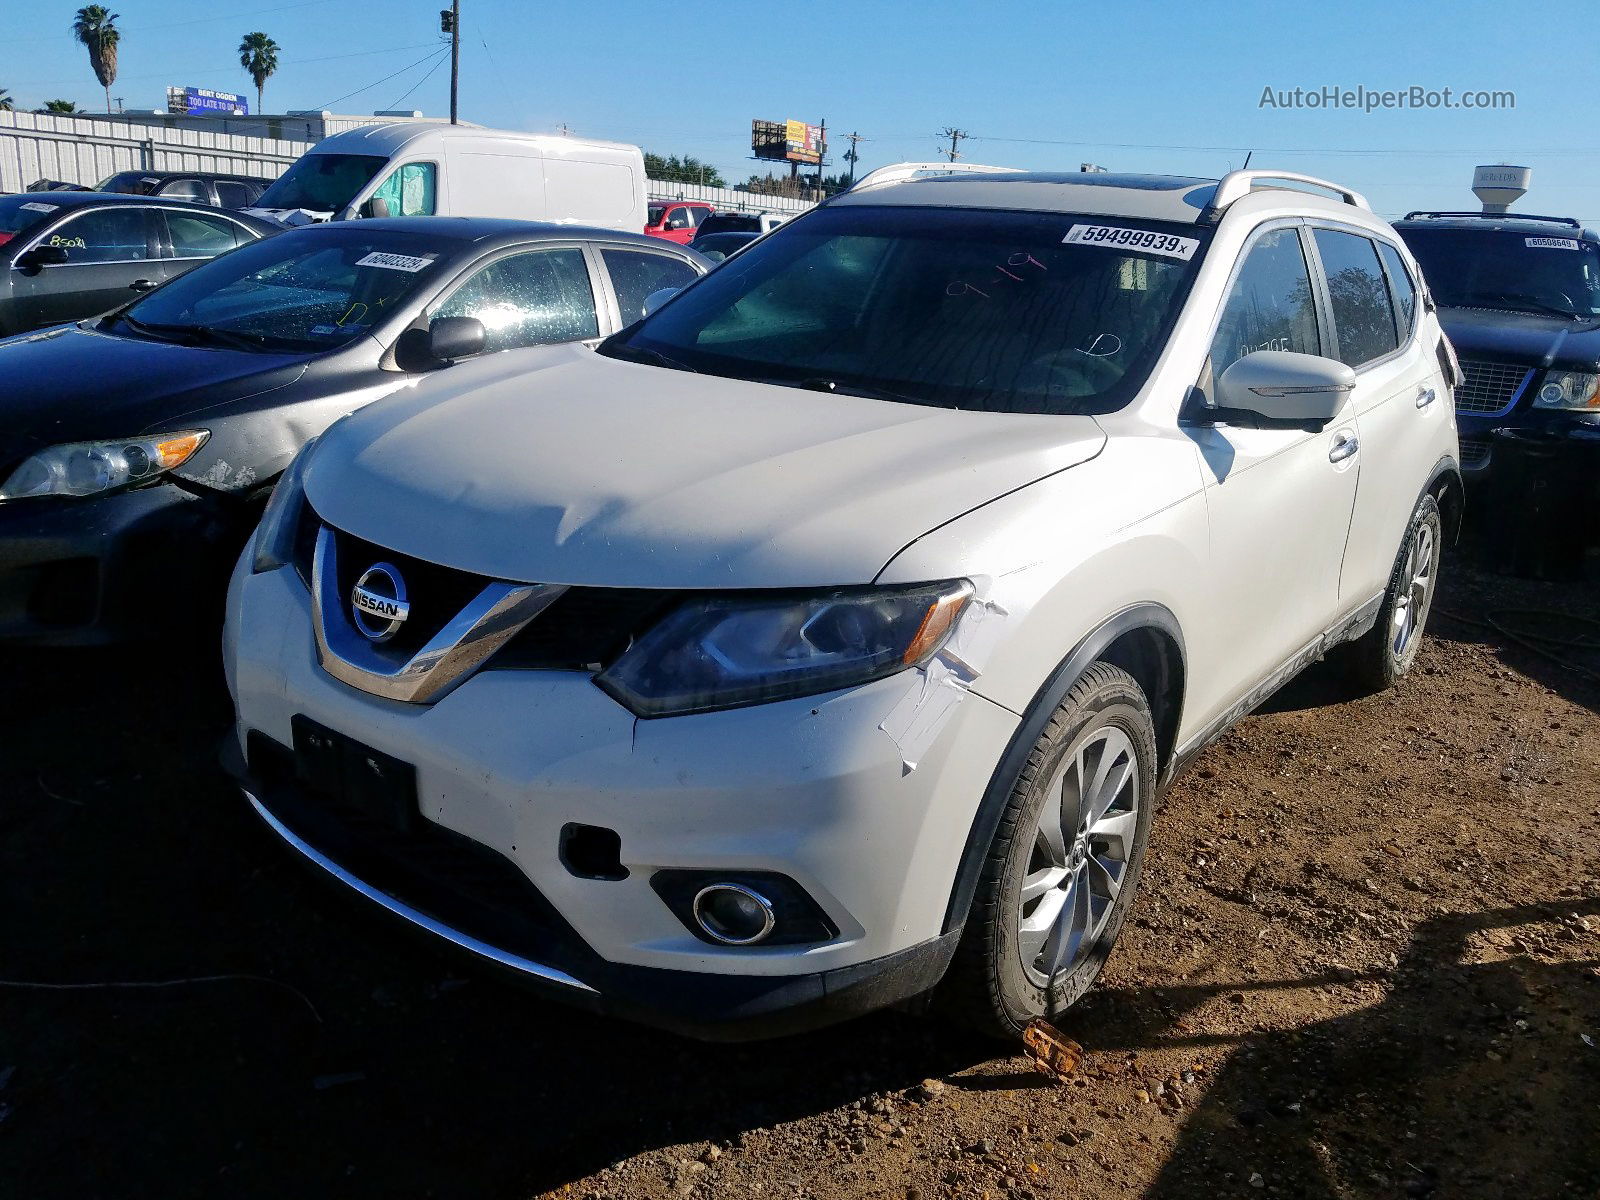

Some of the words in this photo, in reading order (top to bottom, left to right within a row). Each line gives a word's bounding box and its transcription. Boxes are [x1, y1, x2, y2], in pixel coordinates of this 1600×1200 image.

[189, 96, 202, 107] TOO
[203, 98, 218, 110] LATE
[219, 101, 226, 111] TO
[197, 89, 215, 98] BERT
[215, 92, 238, 102] OGDEN
[1075, 333, 1122, 357] D
[353, 588, 398, 617] NISSAN
